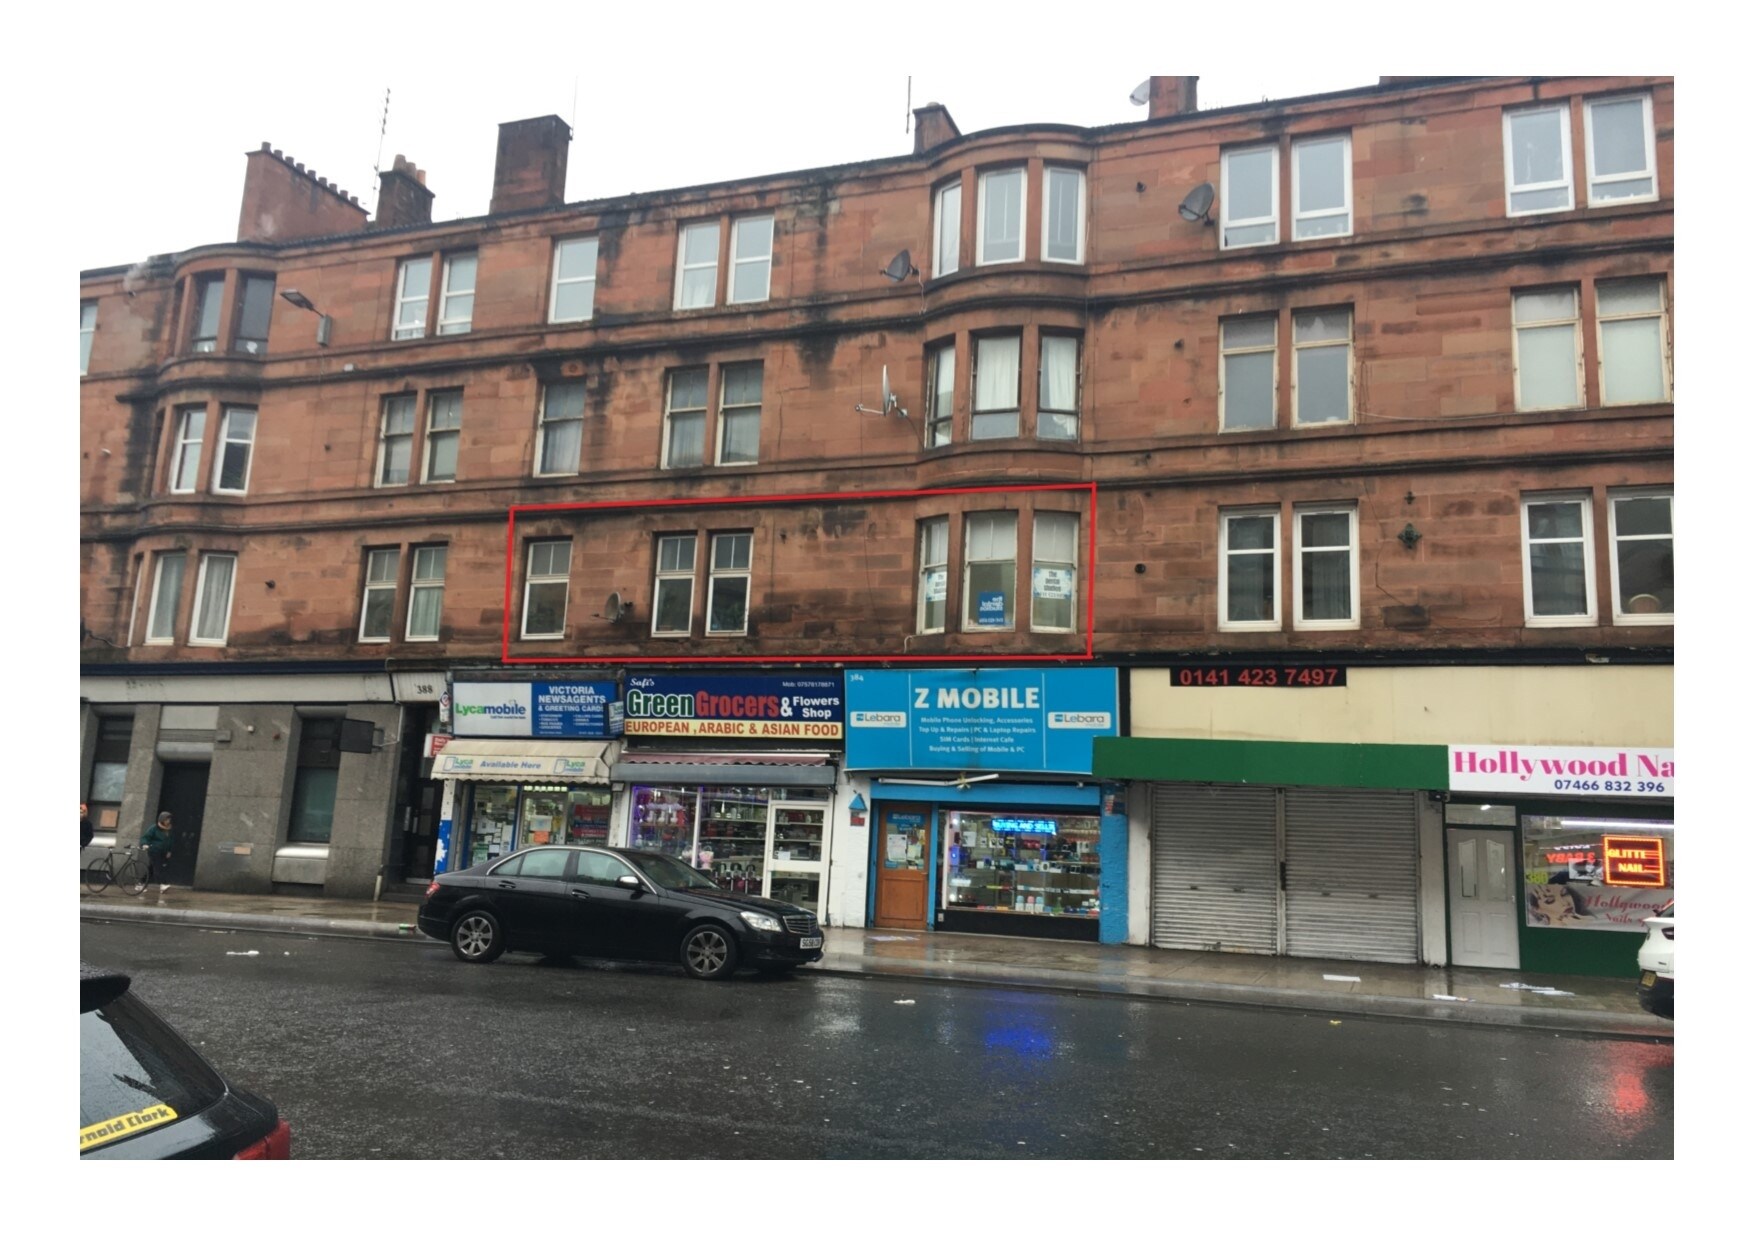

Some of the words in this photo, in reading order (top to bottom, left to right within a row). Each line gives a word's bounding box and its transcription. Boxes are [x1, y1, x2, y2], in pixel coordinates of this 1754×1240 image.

[629, 678, 655, 688] Safi's
[1179, 669, 1229, 685] 0141
[1238, 669, 1278, 685] 423
[1284, 669, 1339, 685] 7497
[416, 685, 433, 694] 388
[548, 686, 595, 695] VICTORIA
[538, 695, 606, 704] NEWSAGENTS
[627, 688, 695, 717] Green
[695, 690, 780, 718] Grocers
[780, 697, 793, 717] &
[792, 696, 840, 706] Flowers
[913, 688, 930, 709] Z
[937, 687, 1040, 709] MOBILE
[455, 702, 526, 716] Lycamobile
[802, 707, 832, 719] Shop
[864, 713, 901, 722] Lebara
[1064, 714, 1105, 723] Lebara
[625, 721, 689, 733] EUROPEAN
[748, 723, 758, 734] &
[761, 723, 800, 735] ASIAN
[804, 724, 839, 736] FOOD
[480, 760, 519, 768] Available
[1453, 751, 1629, 781] Hollywood
[1554, 779, 1599, 791] 07466
[1604, 780, 1632, 792] 832
[1637, 781, 1665, 793] 396
[126, 1108, 170, 1127] Clark
